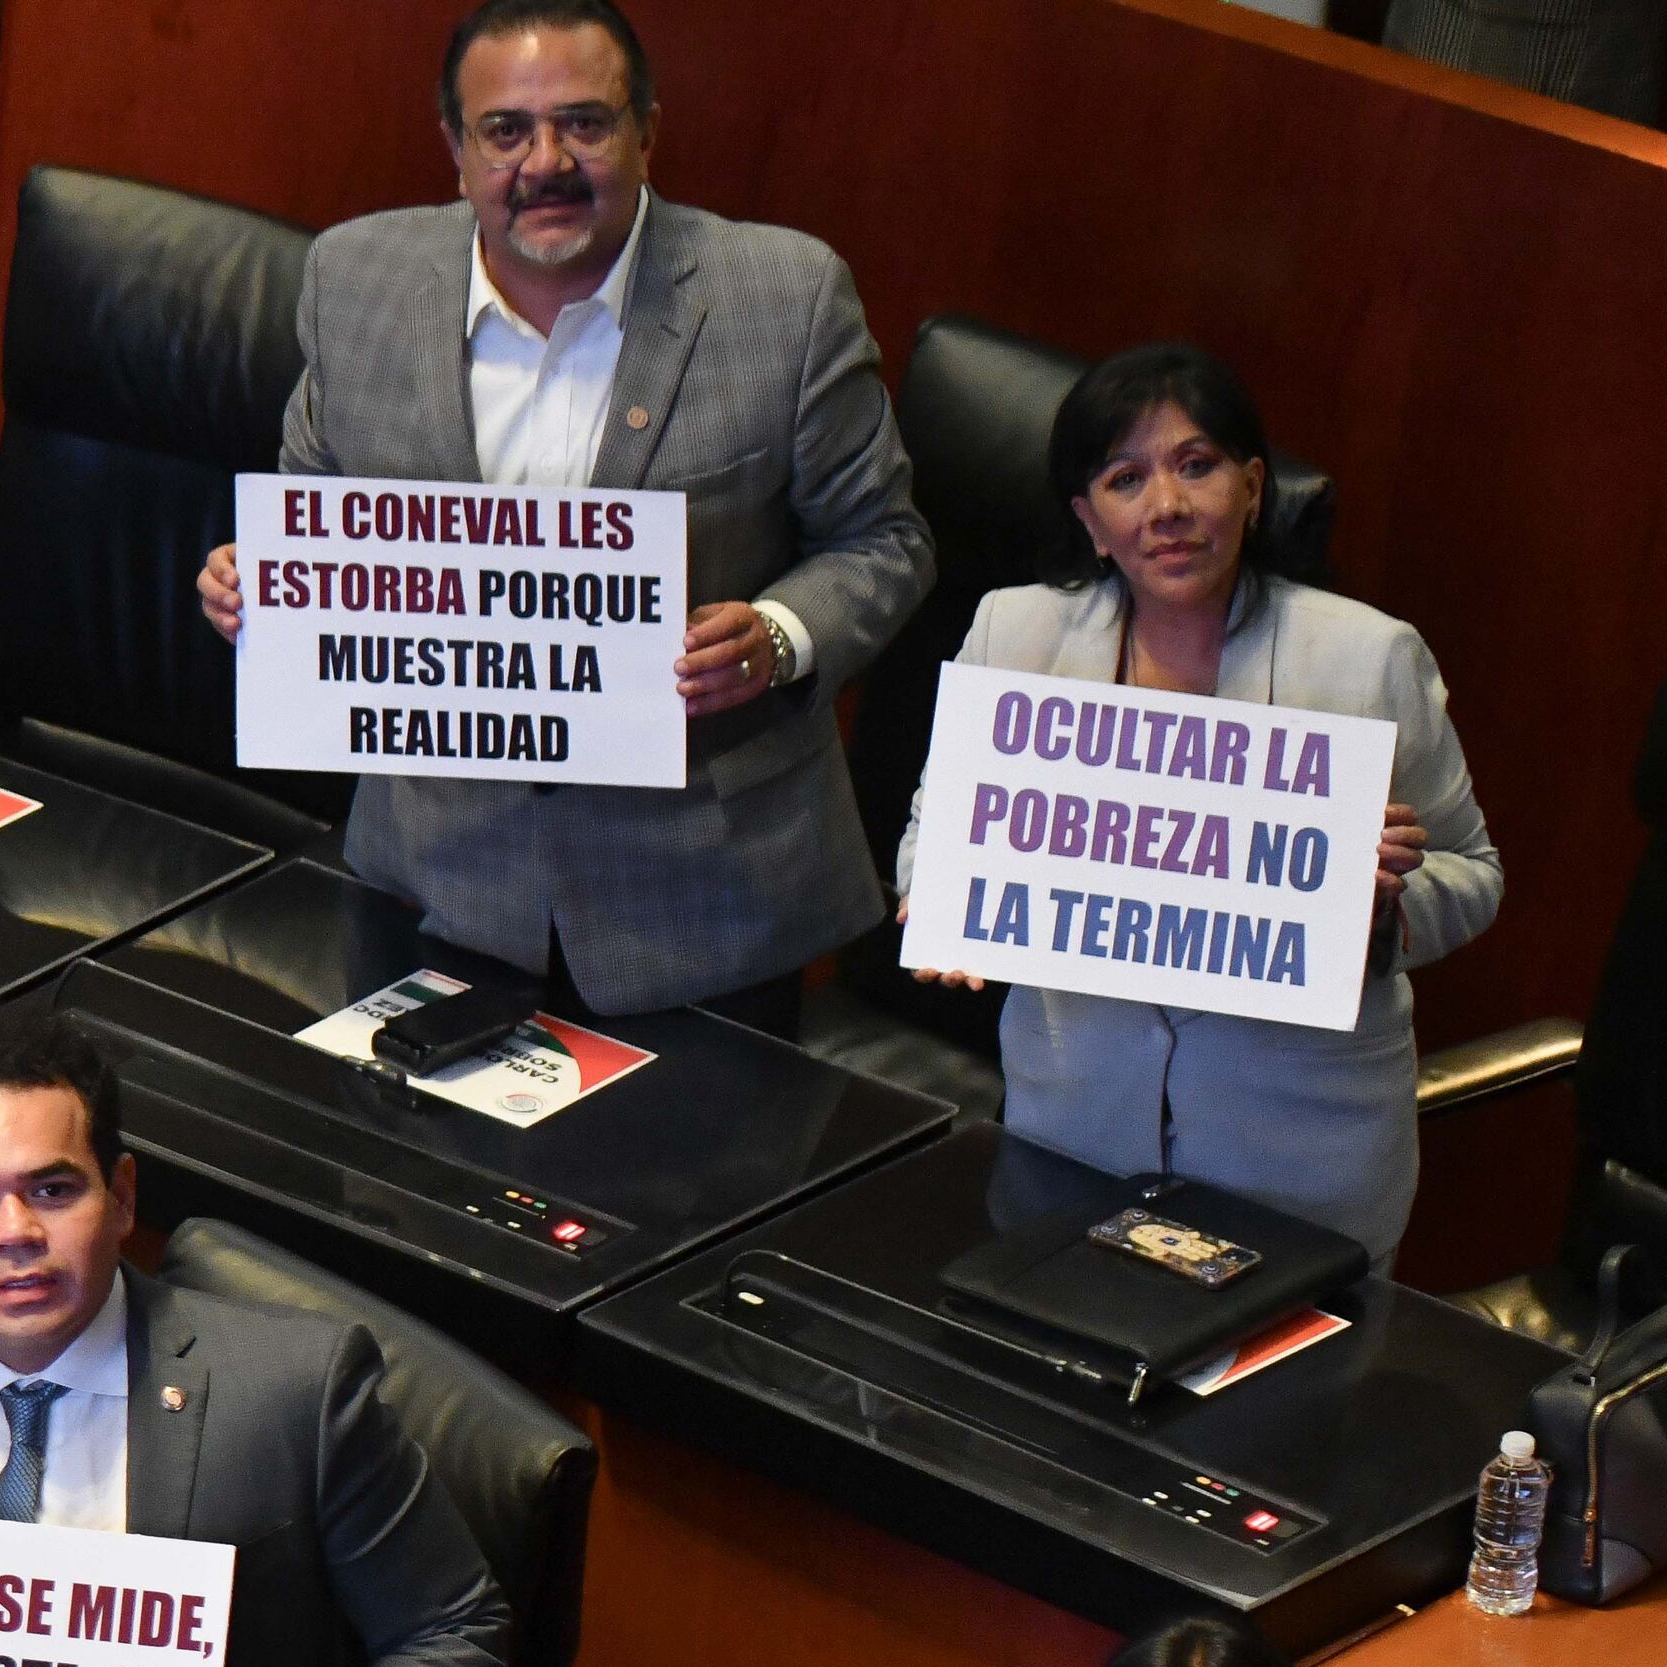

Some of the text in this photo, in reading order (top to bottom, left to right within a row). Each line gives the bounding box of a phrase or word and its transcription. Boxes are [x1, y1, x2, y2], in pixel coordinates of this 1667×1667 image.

[285, 490, 634, 551] EL CONEVAL LES
[259, 560, 661, 627] ESTORBA PORQUE
[319, 634, 602, 692] MUESTRA LA
[351, 707, 568, 762] REALIDAD
[993, 692, 1329, 797] OCULTAR LA
[970, 784, 1328, 892] POBREZA NO
[963, 877, 1305, 986] LA TERMINA
[68, 1583, 212, 1658] MIDE,
